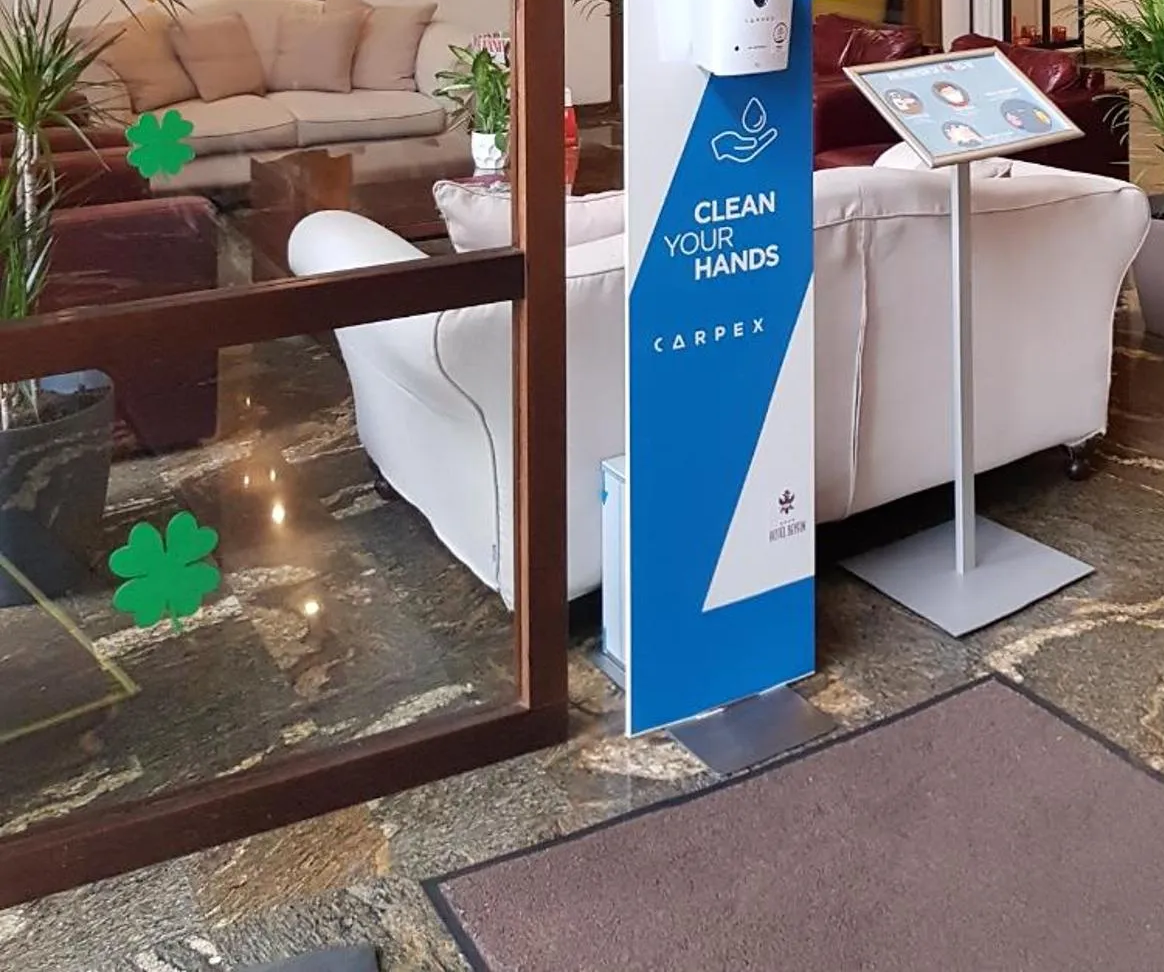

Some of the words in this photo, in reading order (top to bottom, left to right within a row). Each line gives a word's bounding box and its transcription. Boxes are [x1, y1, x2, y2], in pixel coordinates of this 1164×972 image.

[694, 191, 776, 224] CLEAN
[664, 226, 733, 257] YOUR
[694, 245, 780, 280] HANDS
[653, 318, 764, 352] CARPEX
